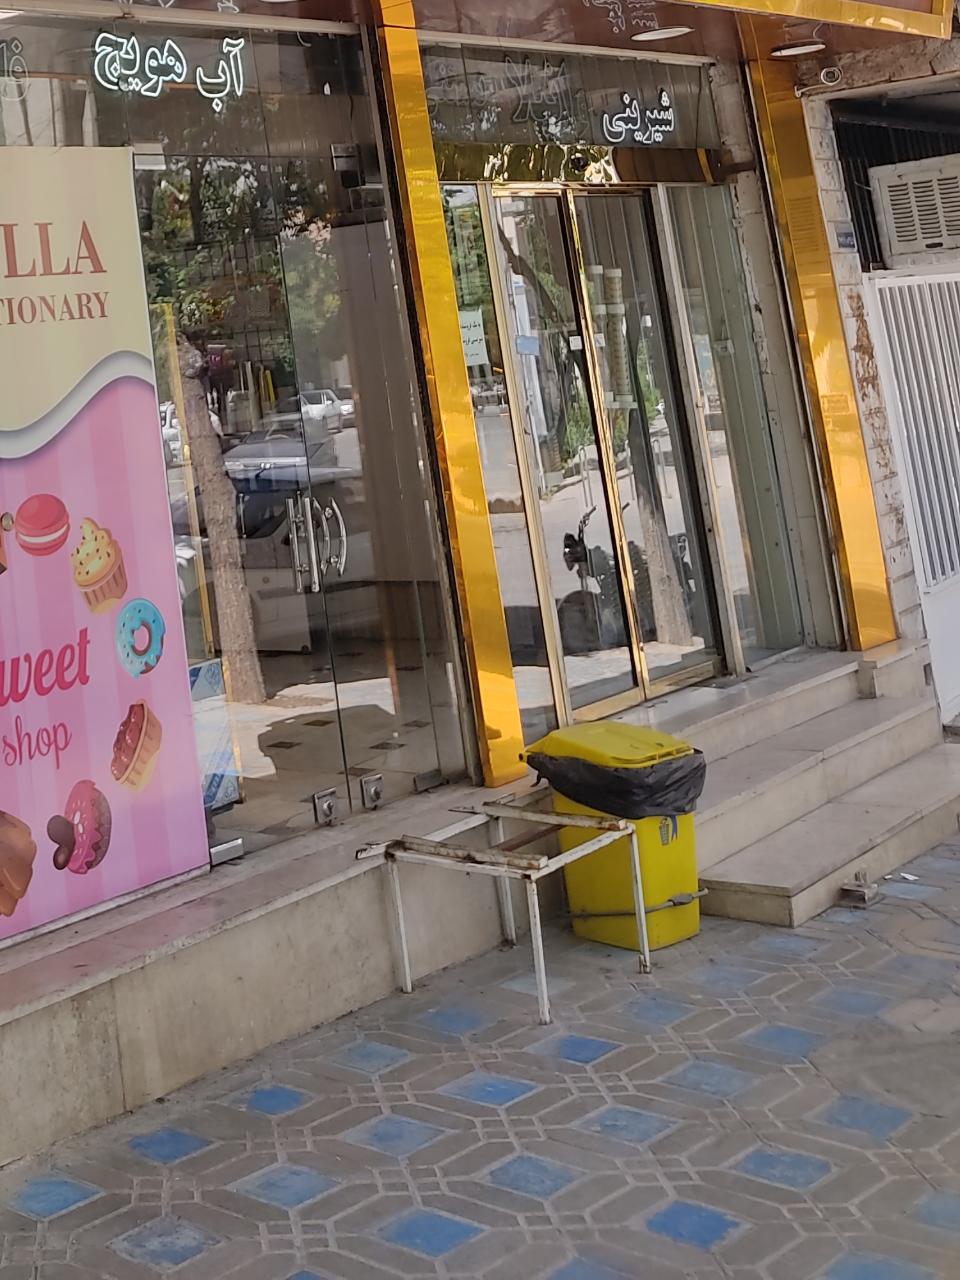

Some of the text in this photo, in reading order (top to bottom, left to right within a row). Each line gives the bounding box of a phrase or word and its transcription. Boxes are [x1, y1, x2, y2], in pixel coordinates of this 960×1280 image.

[94, 32, 245, 113] آب هویج
[603, 90, 676, 144] شیرینی
[2, 715, 72, 770] shop
